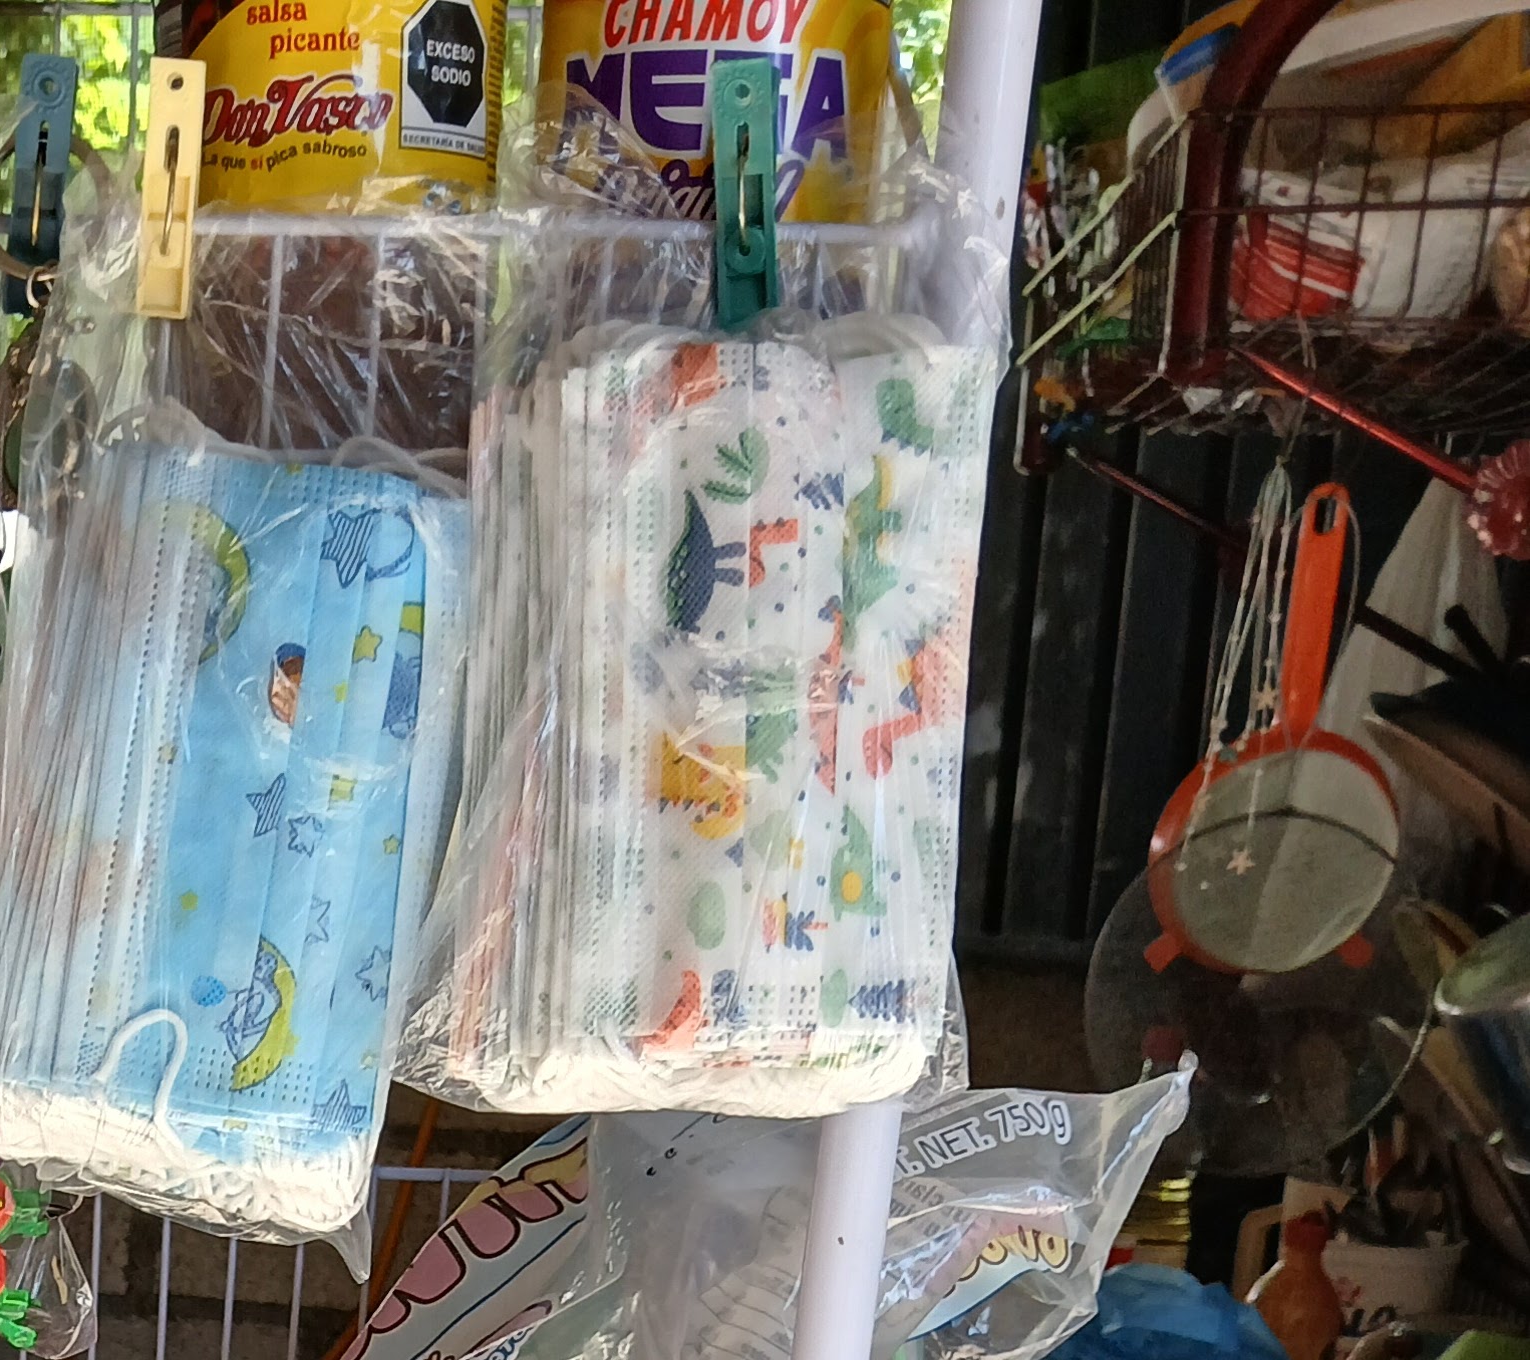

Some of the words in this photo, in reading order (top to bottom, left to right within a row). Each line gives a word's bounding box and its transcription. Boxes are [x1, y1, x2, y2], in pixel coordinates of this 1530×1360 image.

[246, 0, 308, 25] salsa
[604, 0, 808, 48] CHAMOY
[270, 26, 360, 60] picante
[426, 39, 475, 64] EXCESO
[431, 65, 471, 87] SODIO
[204, 89, 270, 146] Don
[566, 49, 848, 160] MEA
[221, 154, 246, 171] que
[267, 145, 297, 172] pica
[303, 140, 367, 158] sabroso
[989, 1100, 1071, 1144] 750g
